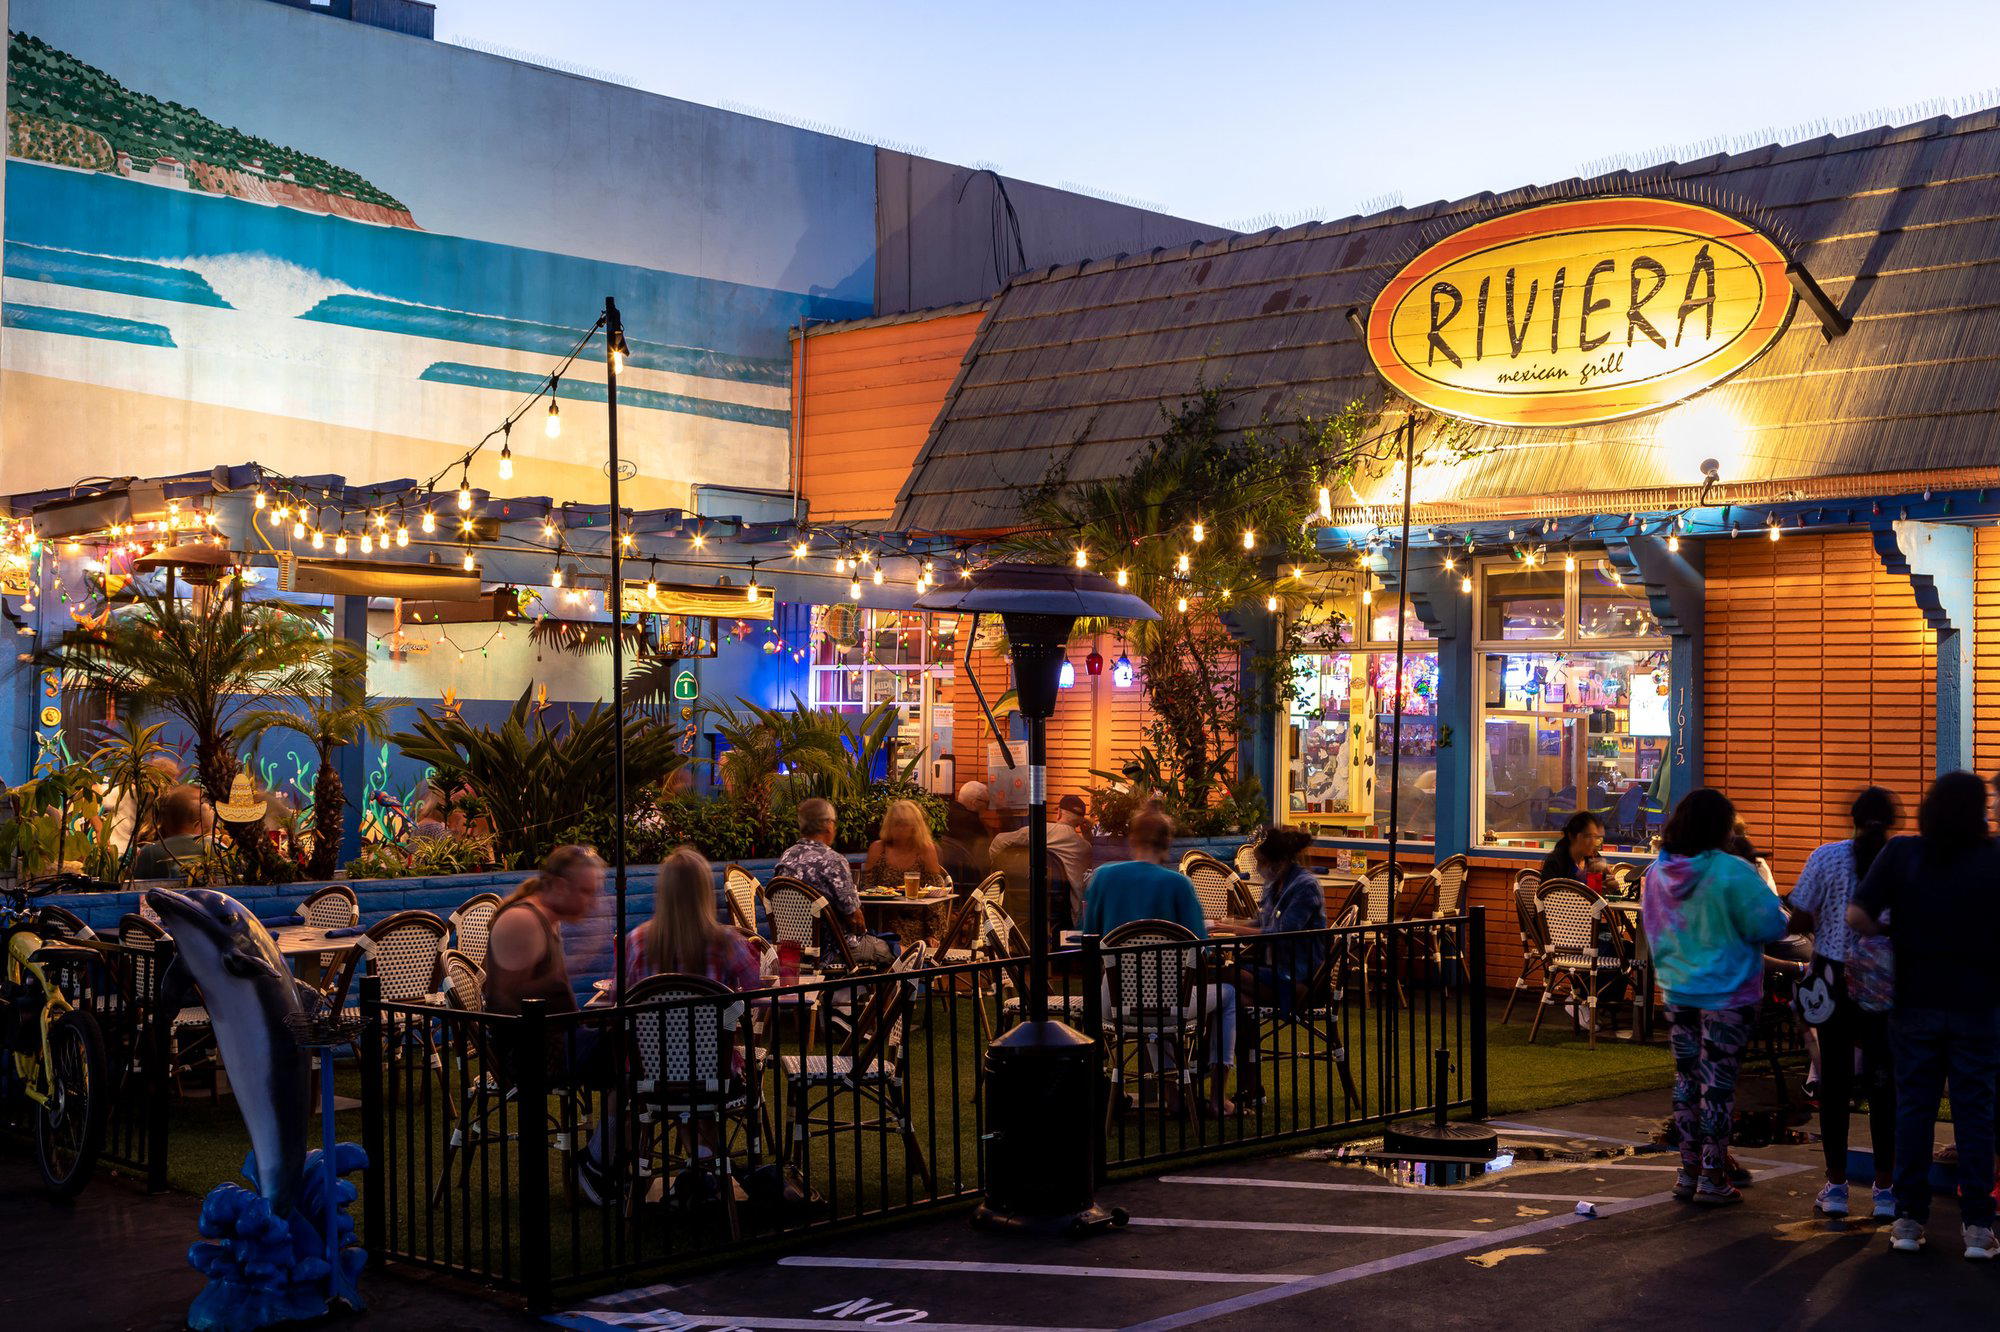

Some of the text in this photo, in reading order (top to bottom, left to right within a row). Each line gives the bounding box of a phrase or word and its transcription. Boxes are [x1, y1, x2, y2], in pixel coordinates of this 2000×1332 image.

[1427, 244, 1716, 369] RIVIERA
[1497, 352, 1624, 386] mexican grill
[683, 682, 688, 695] 1
[1676, 687, 1686, 767] 1615
[812, 1297, 929, 1326] NO
